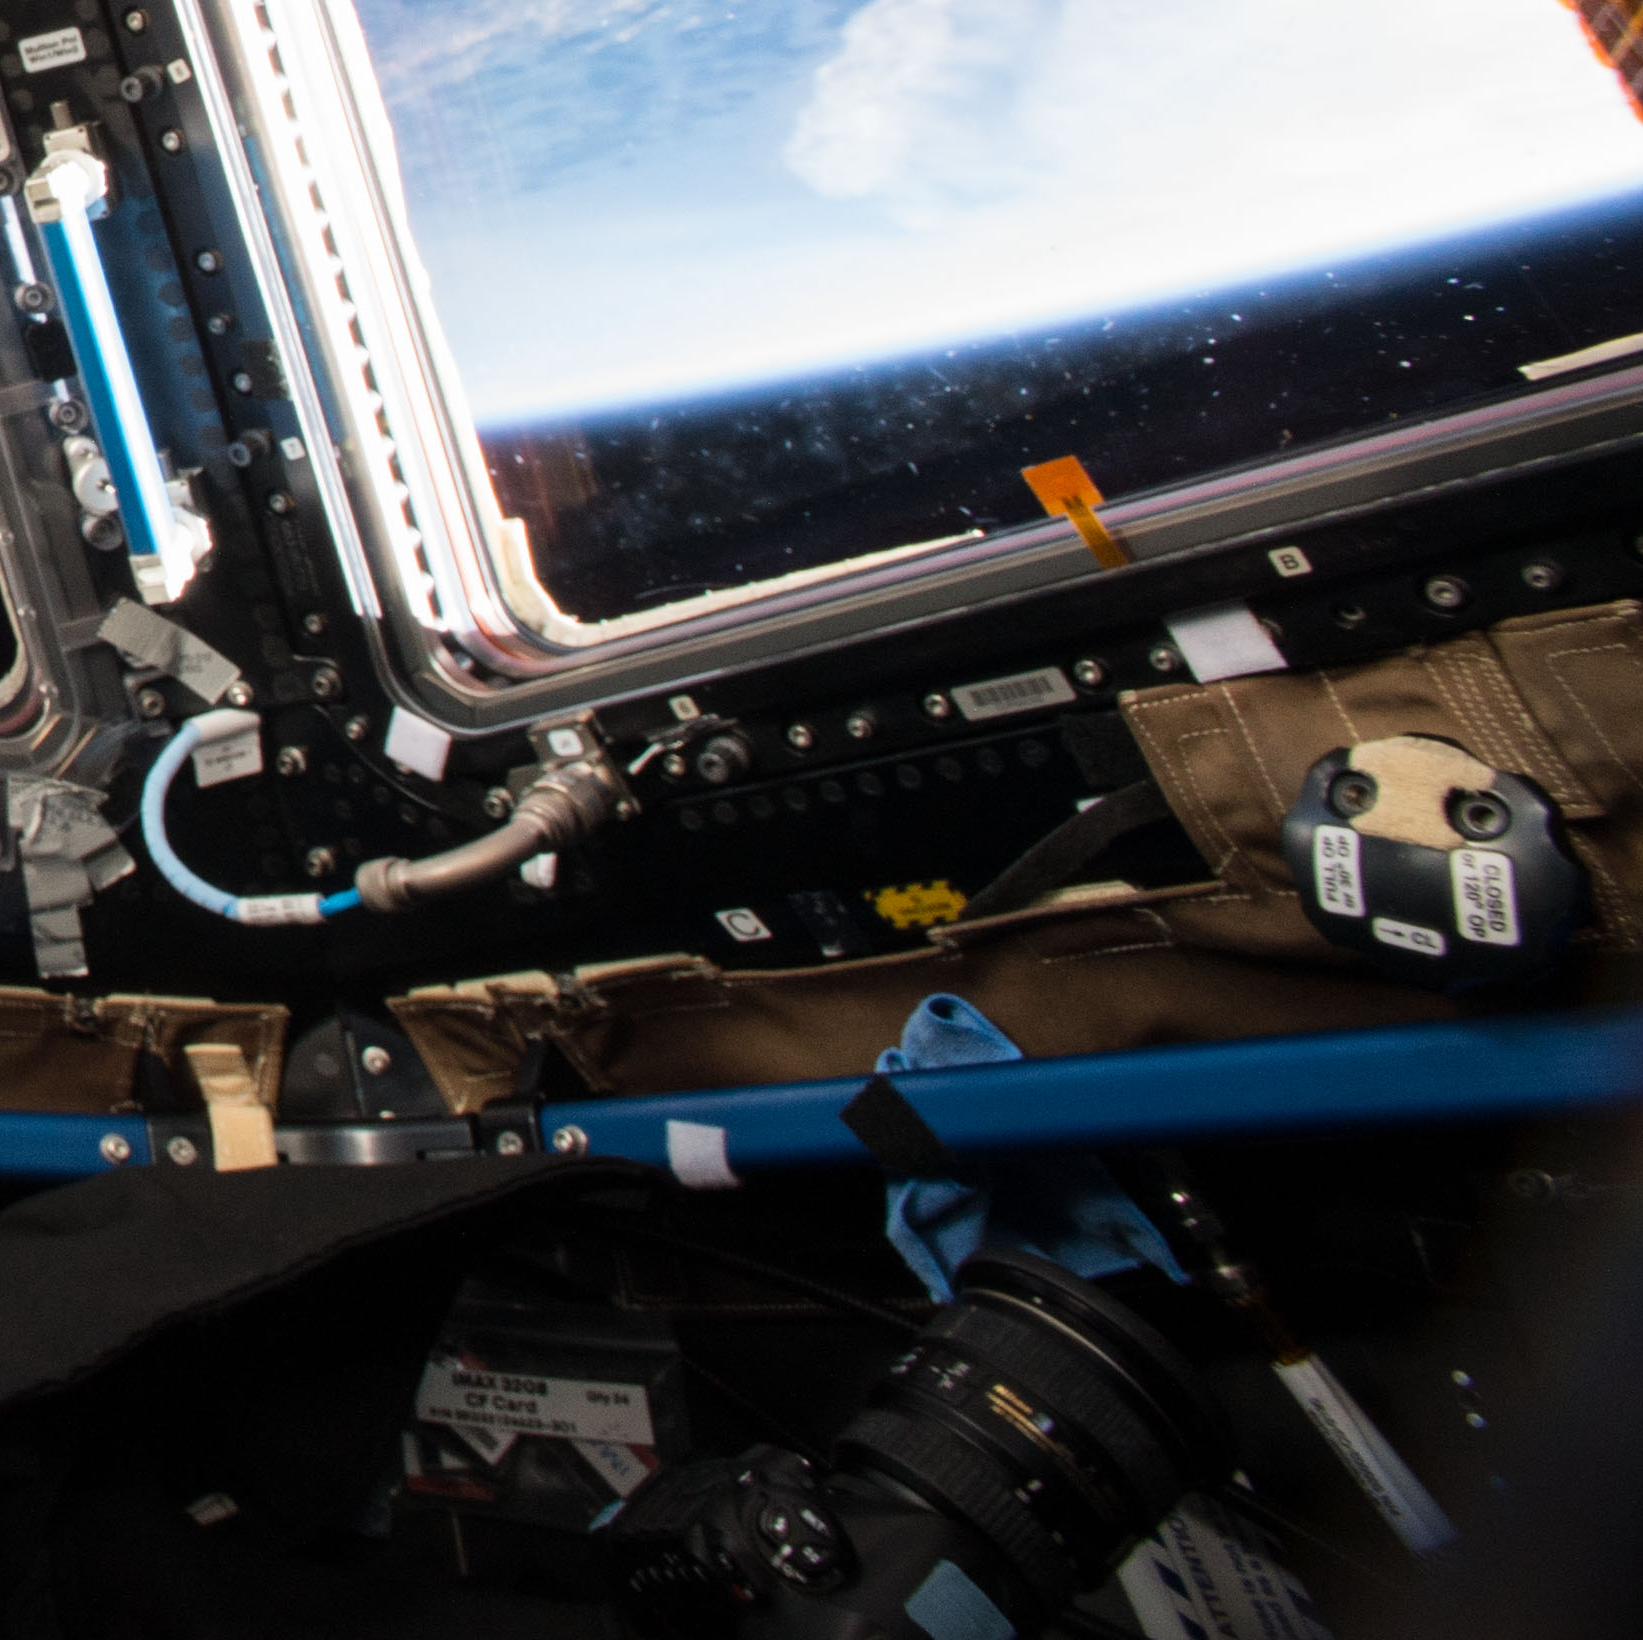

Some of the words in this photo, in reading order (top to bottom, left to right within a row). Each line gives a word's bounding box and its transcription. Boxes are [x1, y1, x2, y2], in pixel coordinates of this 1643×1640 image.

[1279, 554, 1300, 570] B
[1321, 835, 1336, 859] OP
[1336, 834, 1351, 858] OP
[1324, 865, 1340, 903] FULL
[1482, 863, 1508, 933] CLOSED
[727, 911, 760, 937] C
[1466, 914, 1487, 939] OP
[492, 1395, 539, 1413] Card
